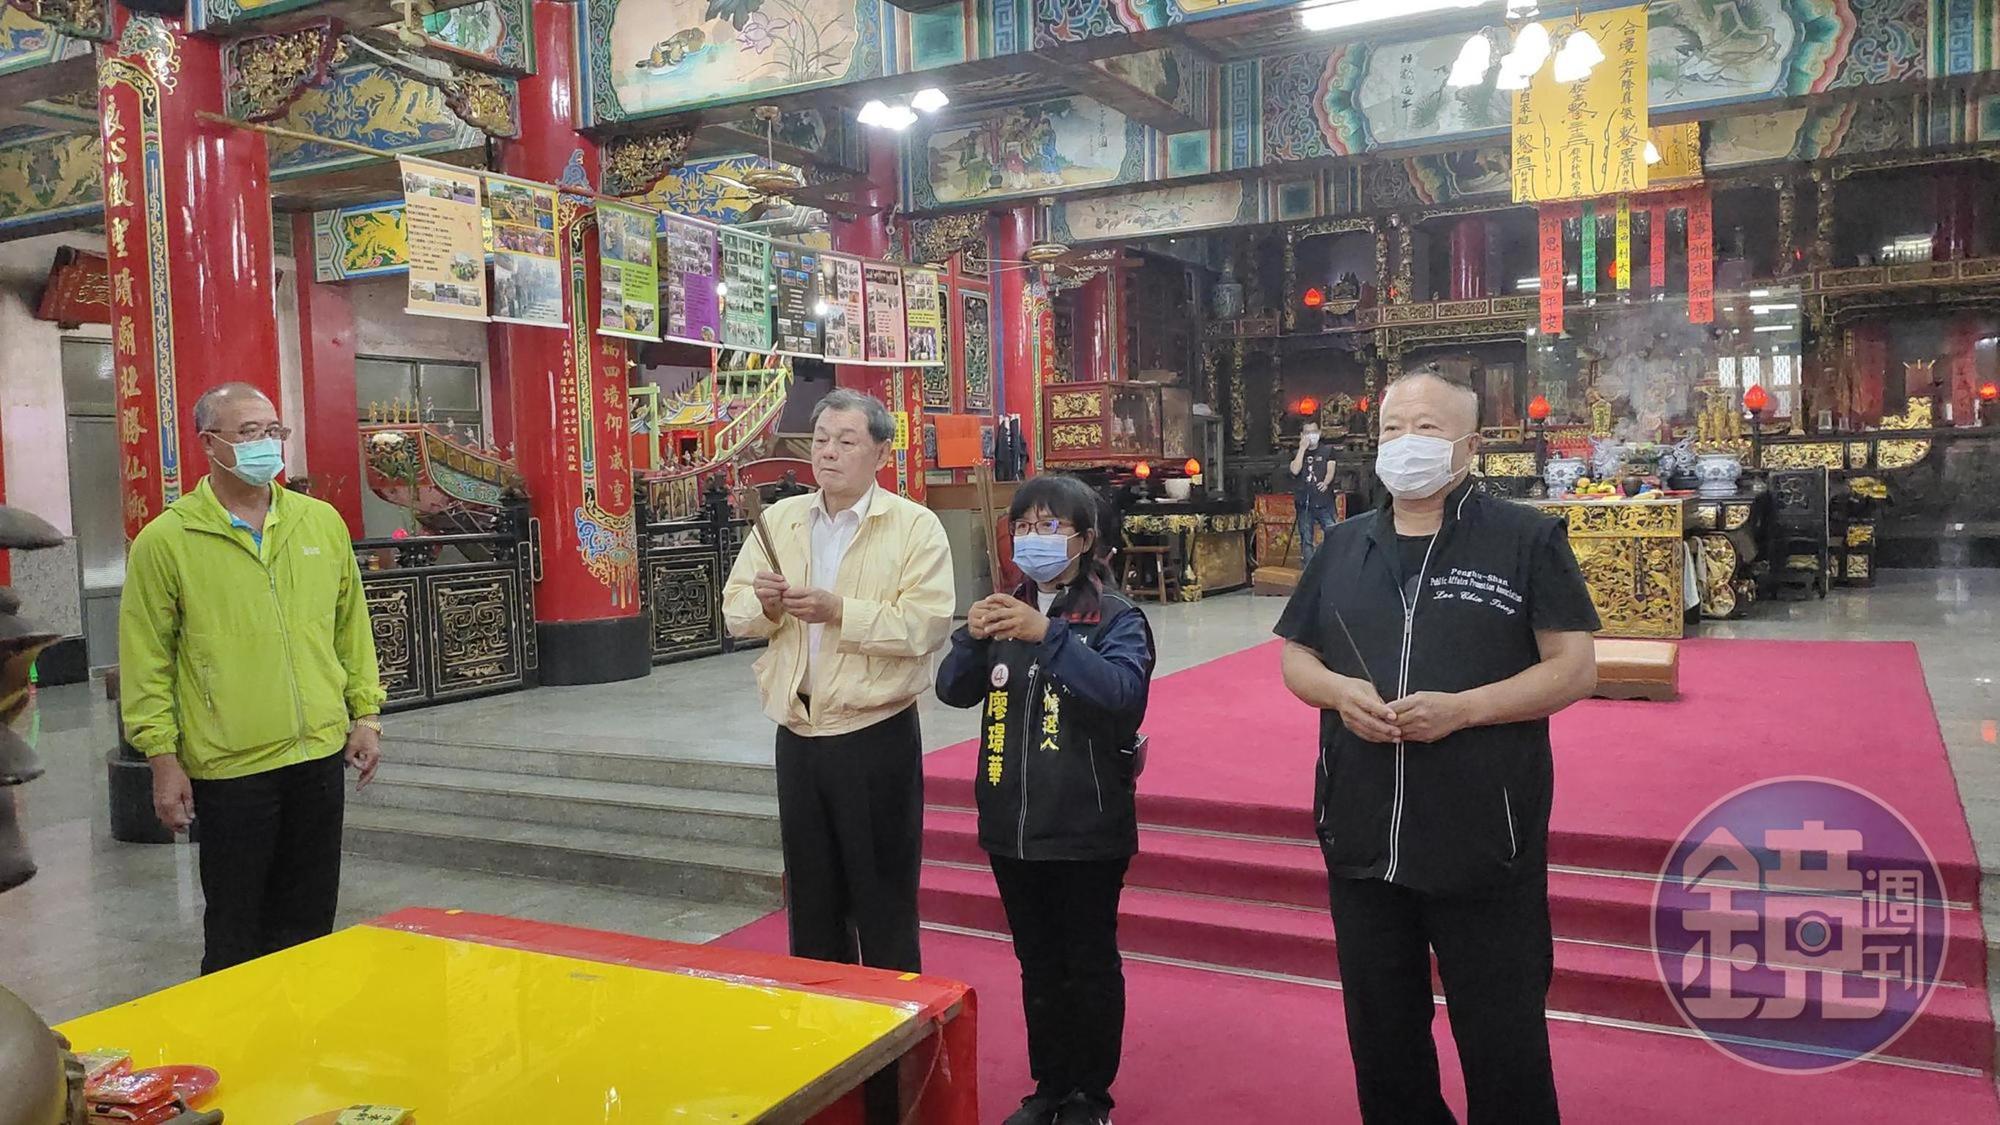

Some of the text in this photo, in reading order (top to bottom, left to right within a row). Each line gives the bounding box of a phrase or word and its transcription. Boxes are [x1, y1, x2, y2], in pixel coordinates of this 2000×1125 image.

[1430, 577, 1447, 586] Public
[1448, 576, 1468, 586] Affairs
[1433, 590, 1454, 600] Lee
[988, 690, 1008, 786] 廖璟華
